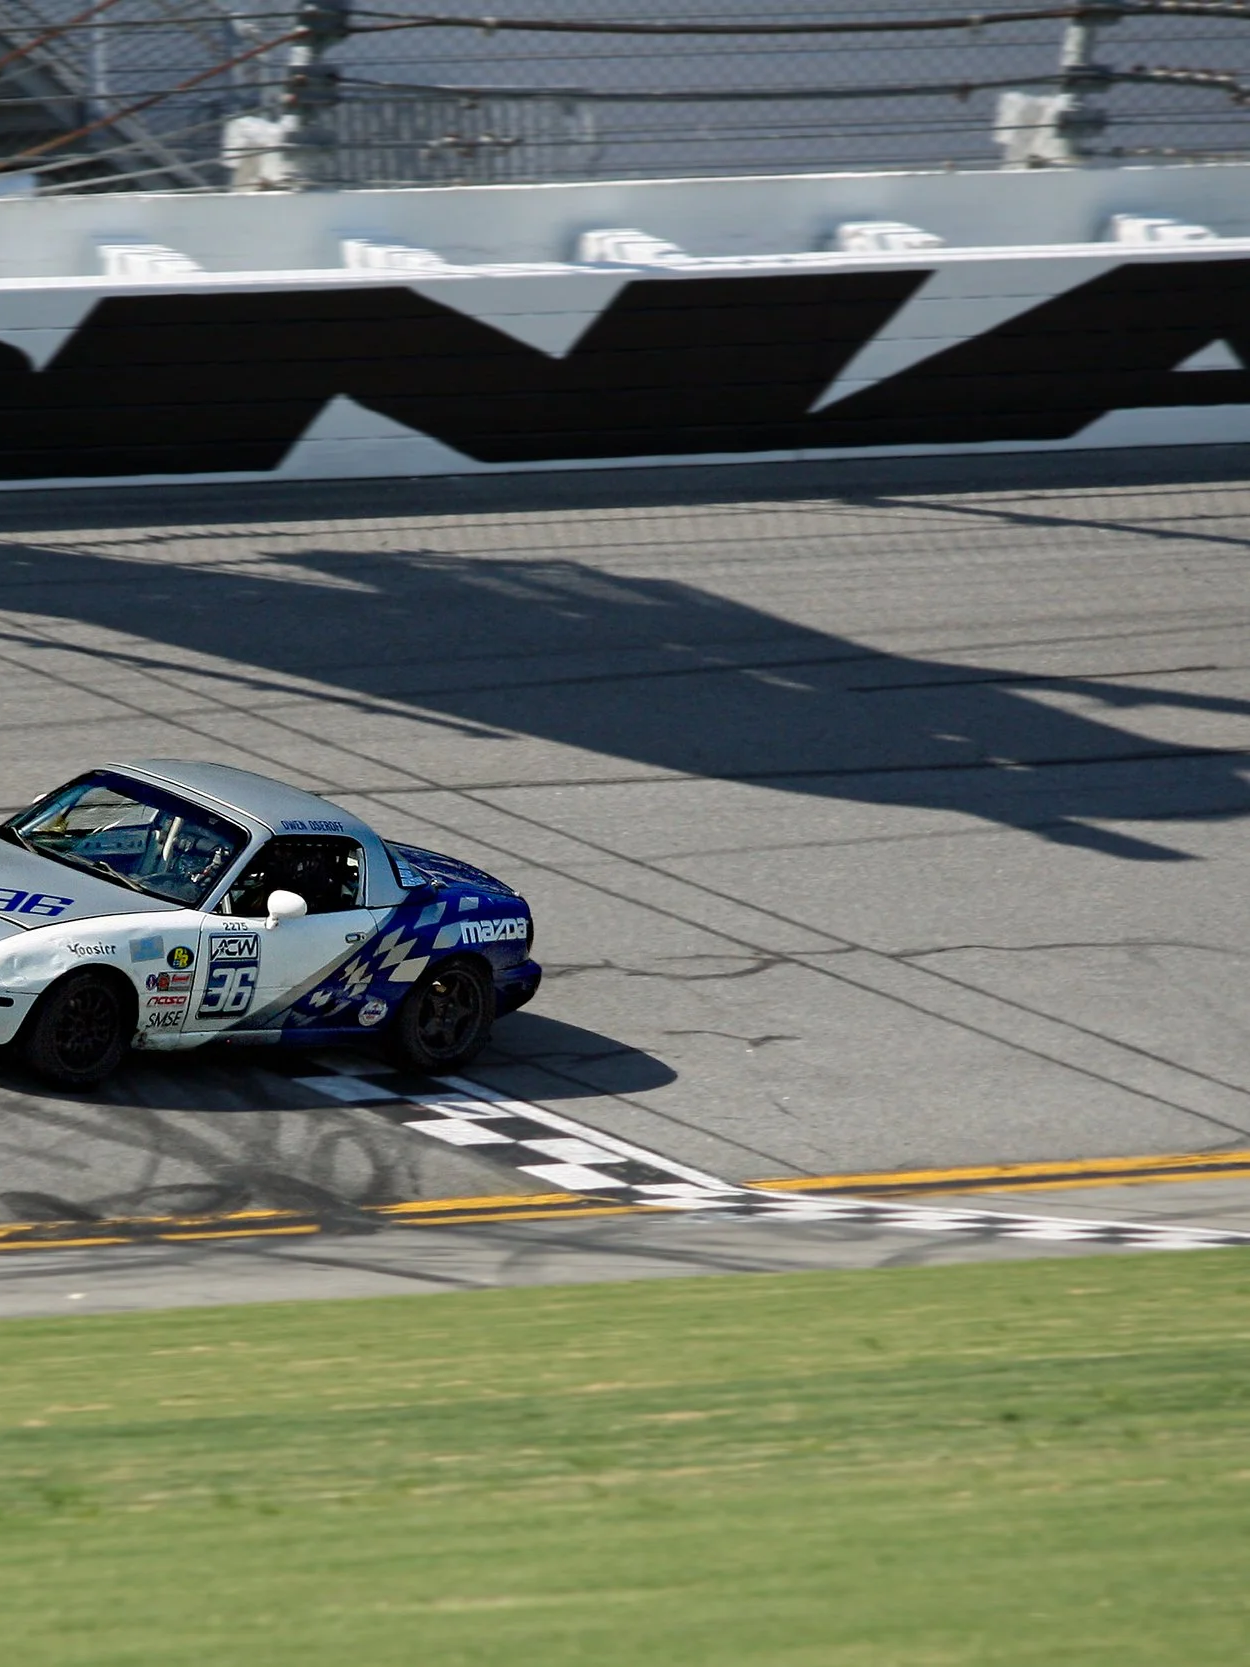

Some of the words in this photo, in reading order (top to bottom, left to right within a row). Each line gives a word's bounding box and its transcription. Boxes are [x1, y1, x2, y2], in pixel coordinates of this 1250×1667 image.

[222, 922, 248, 931] 2275
[460, 917, 528, 944] mazda
[67, 941, 117, 958] Hoosier
[203, 967, 257, 1012] 36
[146, 1010, 183, 1028] SMSE
